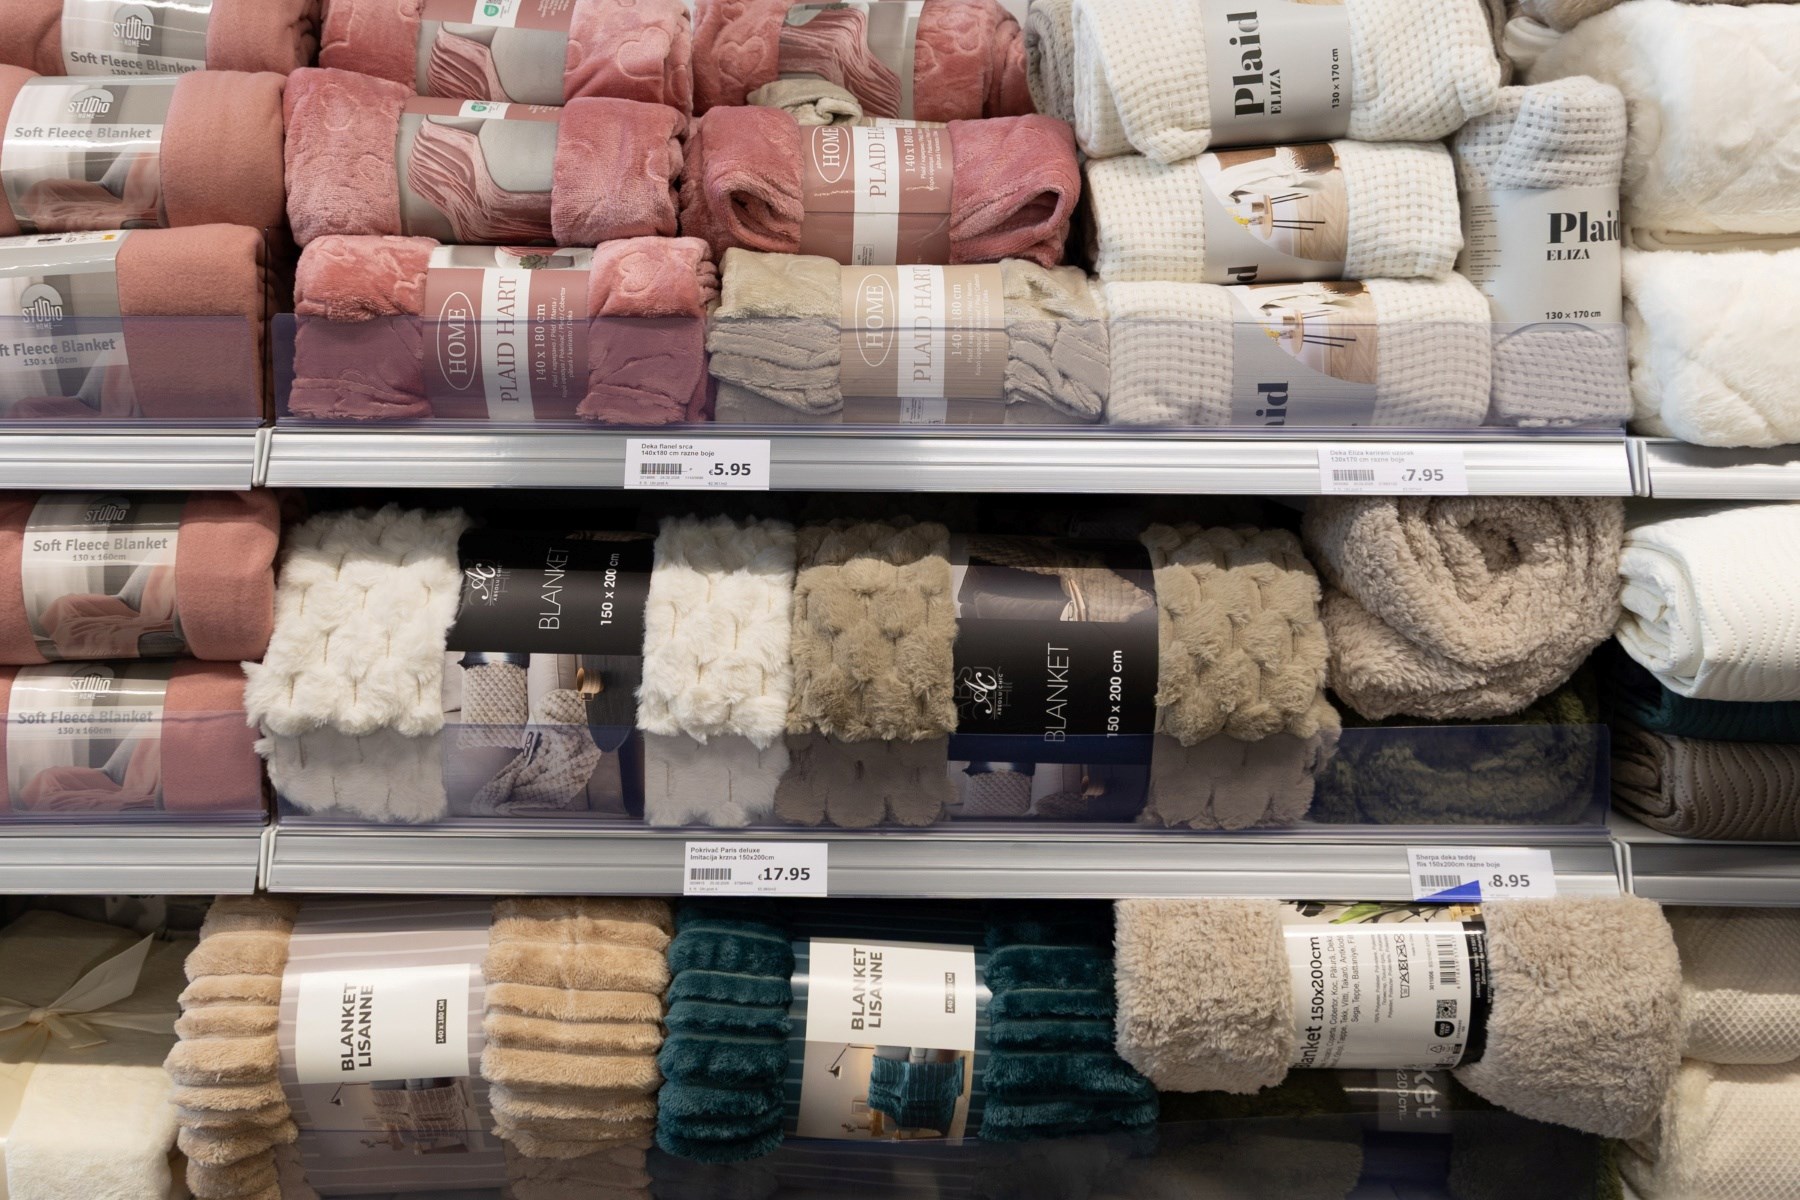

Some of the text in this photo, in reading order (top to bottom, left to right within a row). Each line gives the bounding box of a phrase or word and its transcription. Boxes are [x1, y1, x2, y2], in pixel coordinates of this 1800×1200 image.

[113, 16, 152, 41] STUDIO
[70, 51, 198, 74] Soft Fleece Blanket
[1226, 10, 1265, 119] Plaid
[1332, 48, 1339, 62] cm
[1332, 64, 1340, 82] 170
[1269, 68, 1282, 115] ELIZA
[1332, 92, 1340, 108] 130
[67, 96, 111, 113] STUDIO
[14, 127, 153, 139] Soft Fleece Blanket
[822, 128, 840, 167] HOME
[869, 142, 886, 198] PLAID
[905, 154, 915, 173] 140
[1547, 210, 1620, 244] Plaid
[1546, 248, 1590, 261] ELIZA
[912, 266, 931, 309] HART
[21, 298, 63, 323] STUDIO
[536, 303, 546, 323] cm
[865, 285, 884, 349] HOME
[951, 284, 962, 356] 140 180 cm
[1545, 311, 1563, 320] 130
[1573, 310, 1590, 318] 170
[0, 337, 116, 357] ft Fleece Blanket
[447, 308, 467, 375] HOME
[496, 276, 520, 403] PLAID HART
[535, 326, 546, 348] 180
[913, 315, 931, 383] PLAID
[23, 357, 40, 367] 130
[48, 355, 78, 365] 160cm
[536, 359, 547, 382] 140
[708, 463, 751, 476] €5.95
[1401, 468, 1444, 482] €7.95
[85, 505, 126, 521] STUDIO
[33, 536, 168, 552] Soft Fleece Blanket
[72, 553, 88, 562] 130
[97, 553, 126, 562] 160cm
[538, 546, 569, 630] BLANKET
[600, 553, 620, 626] 150 x 200 cm
[69, 673, 111, 692] STUDIO
[1044, 642, 1069, 742] BLANKET
[1107, 650, 1123, 738] 150 x 200 cm
[17, 710, 154, 724] Soft Fleece Blanket
[57, 727, 73, 735] 130
[82, 726, 112, 735] 160cm
[1416, 854, 1439, 862] Sherpa
[757, 867, 811, 881] €17.95
[1488, 874, 1530, 888] €8.95
[851, 947, 867, 1031] BLANKET
[1309, 936, 1325, 1022] 150x200cm
[1331, 980, 1339, 996] Koc,
[1349, 945, 1361, 1023] Sega, Teppe, Battaniye,
[868, 952, 883, 1029] LISANNE
[438, 1000, 446, 1011] CM
[1329, 996, 1339, 1025] Cobertor,
[341, 982, 357, 1072] BLANKET
[358, 984, 374, 1068] LISANNE
[437, 1012, 445, 1024] 180
[437, 1030, 445, 1043] 140
